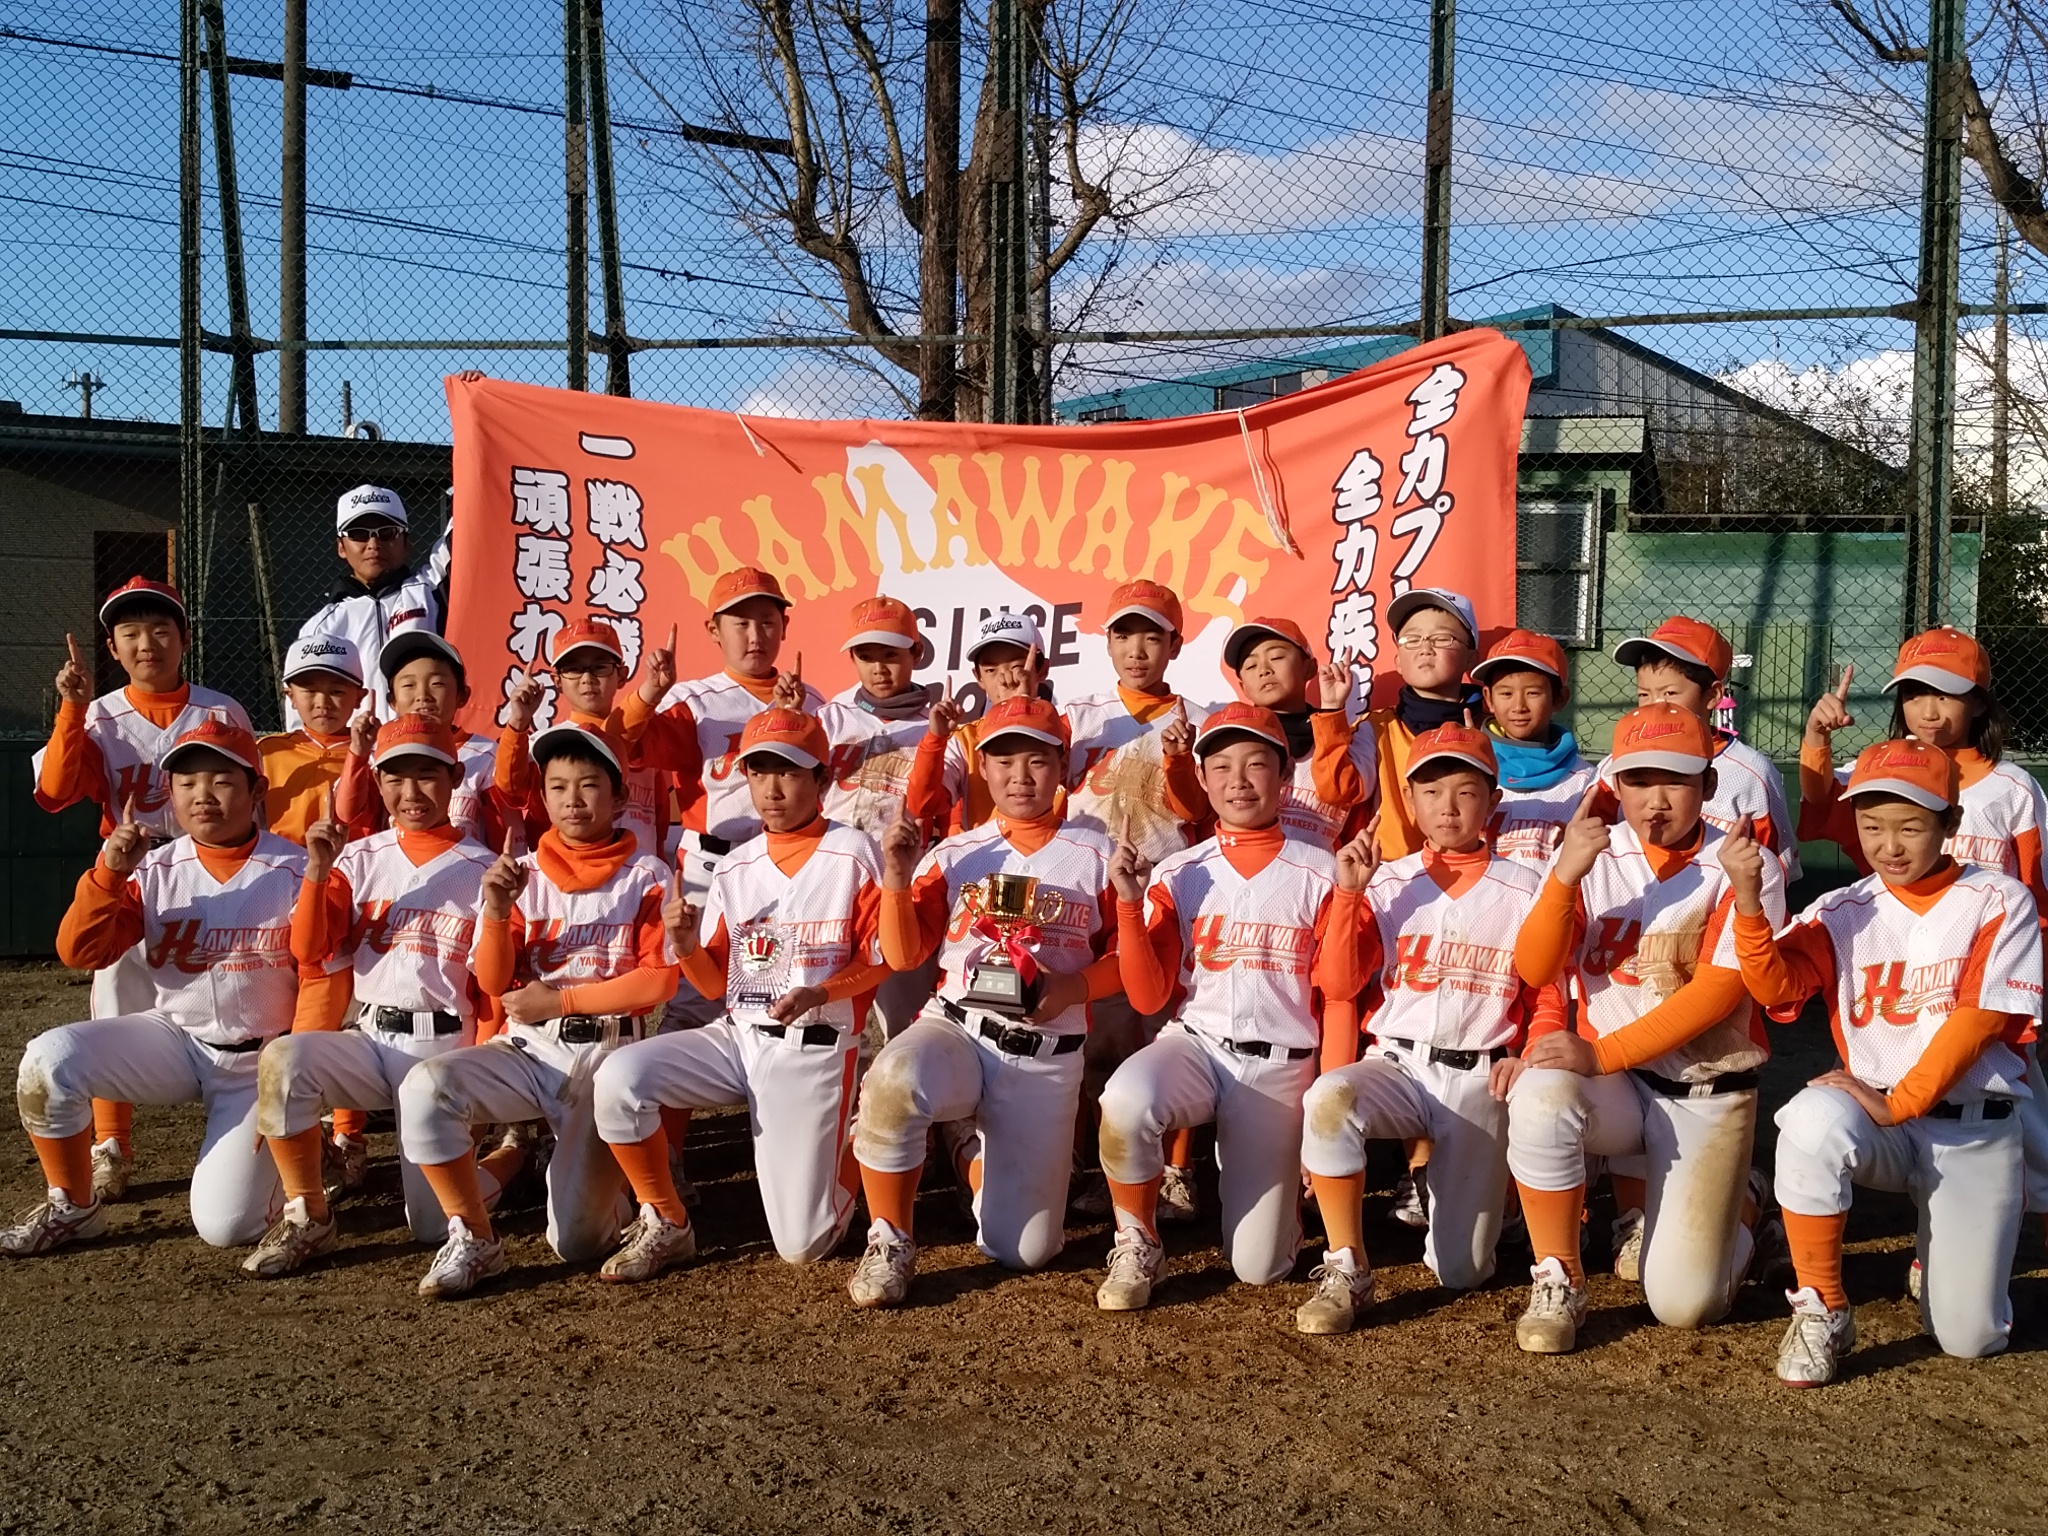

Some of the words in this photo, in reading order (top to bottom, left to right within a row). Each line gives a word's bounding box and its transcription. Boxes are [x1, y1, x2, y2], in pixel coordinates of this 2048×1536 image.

[1392, 359, 1468, 600] 全力プ
[350, 491, 397, 510] Yankees
[908, 602, 1083, 672] SIE
[981, 617, 1023, 640] Yankees
[301, 641, 347, 660] Yankees
[1383, 933, 1518, 994] HAMAWAK
[1926, 1001, 1957, 1017] YANKE
